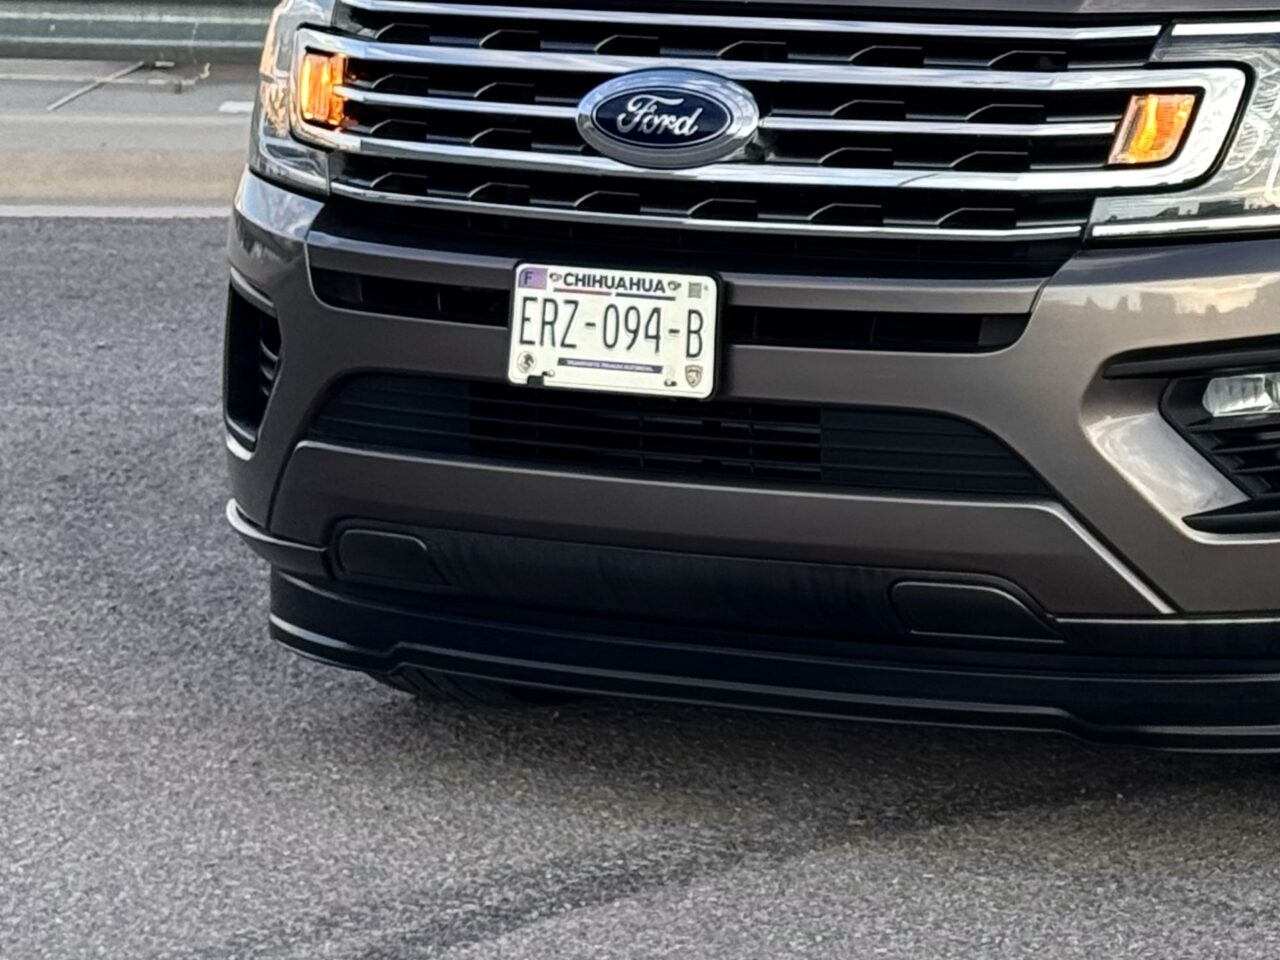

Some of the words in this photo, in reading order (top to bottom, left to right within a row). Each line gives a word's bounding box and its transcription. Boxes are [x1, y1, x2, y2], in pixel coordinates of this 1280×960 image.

[616, 93, 704, 137] Ford
[562, 272, 667, 294] CHIHUAHUA
[518, 296, 704, 359] ERZ-094-B
